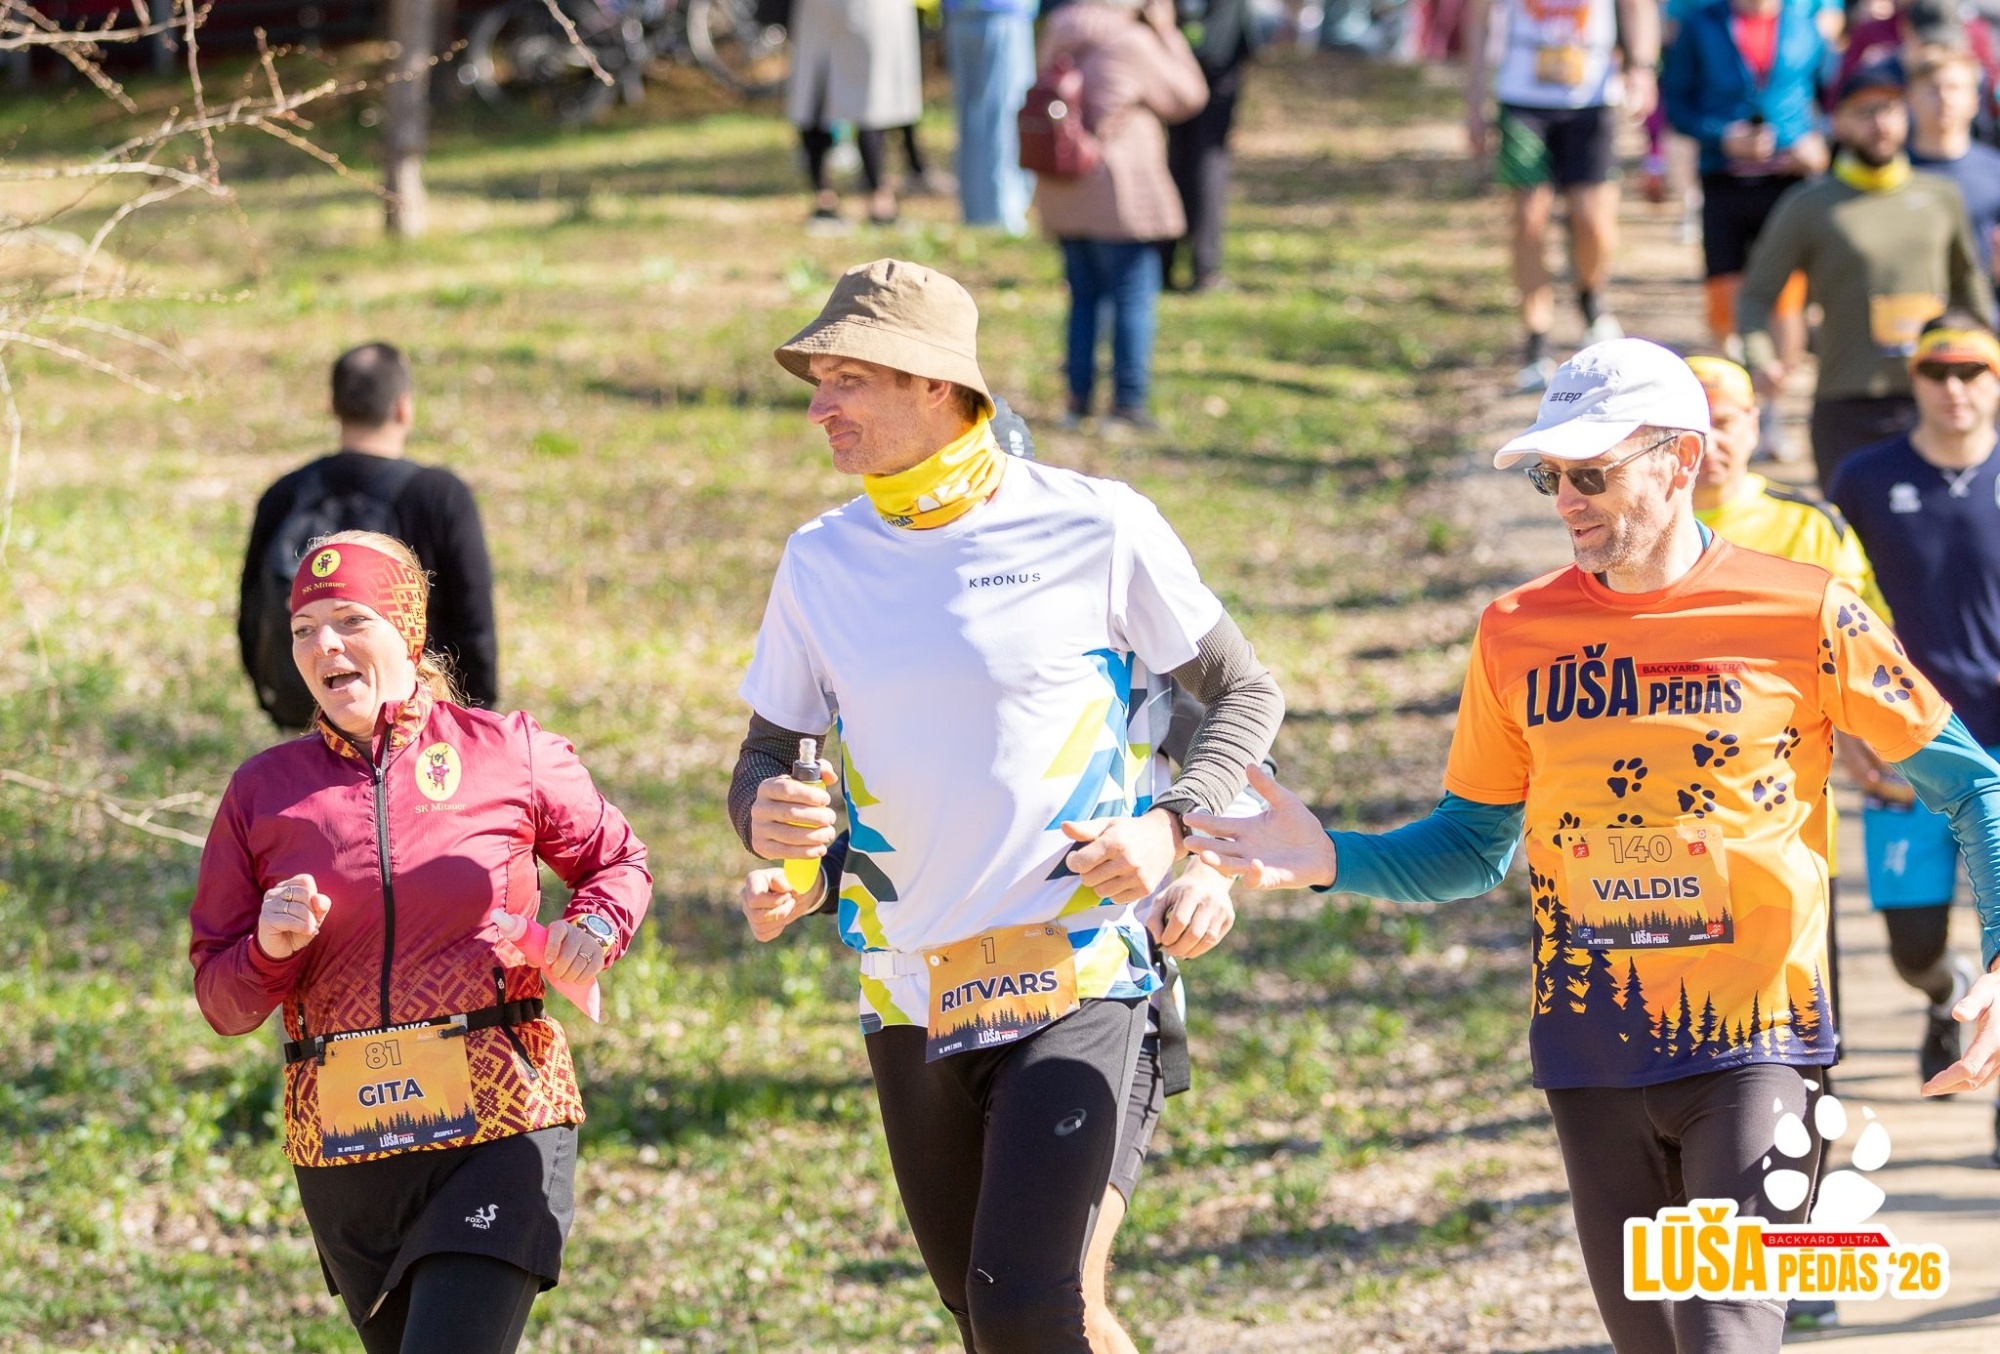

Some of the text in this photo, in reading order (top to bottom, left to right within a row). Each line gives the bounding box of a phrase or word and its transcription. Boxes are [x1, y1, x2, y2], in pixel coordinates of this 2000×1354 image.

[969, 572, 1041, 588] KRONUS
[1642, 661, 1743, 675] BACKYARD ULTRA
[1527, 643, 1743, 727] LŪŠA PĒDĀS
[415, 803, 429, 814] SK
[1608, 835, 1673, 863] 140
[1591, 876, 1700, 901] VALDIS
[981, 937, 996, 964] 1
[941, 970, 1058, 1013] RITVARS
[365, 1039, 402, 1069] 81
[358, 1078, 425, 1107] GITA
